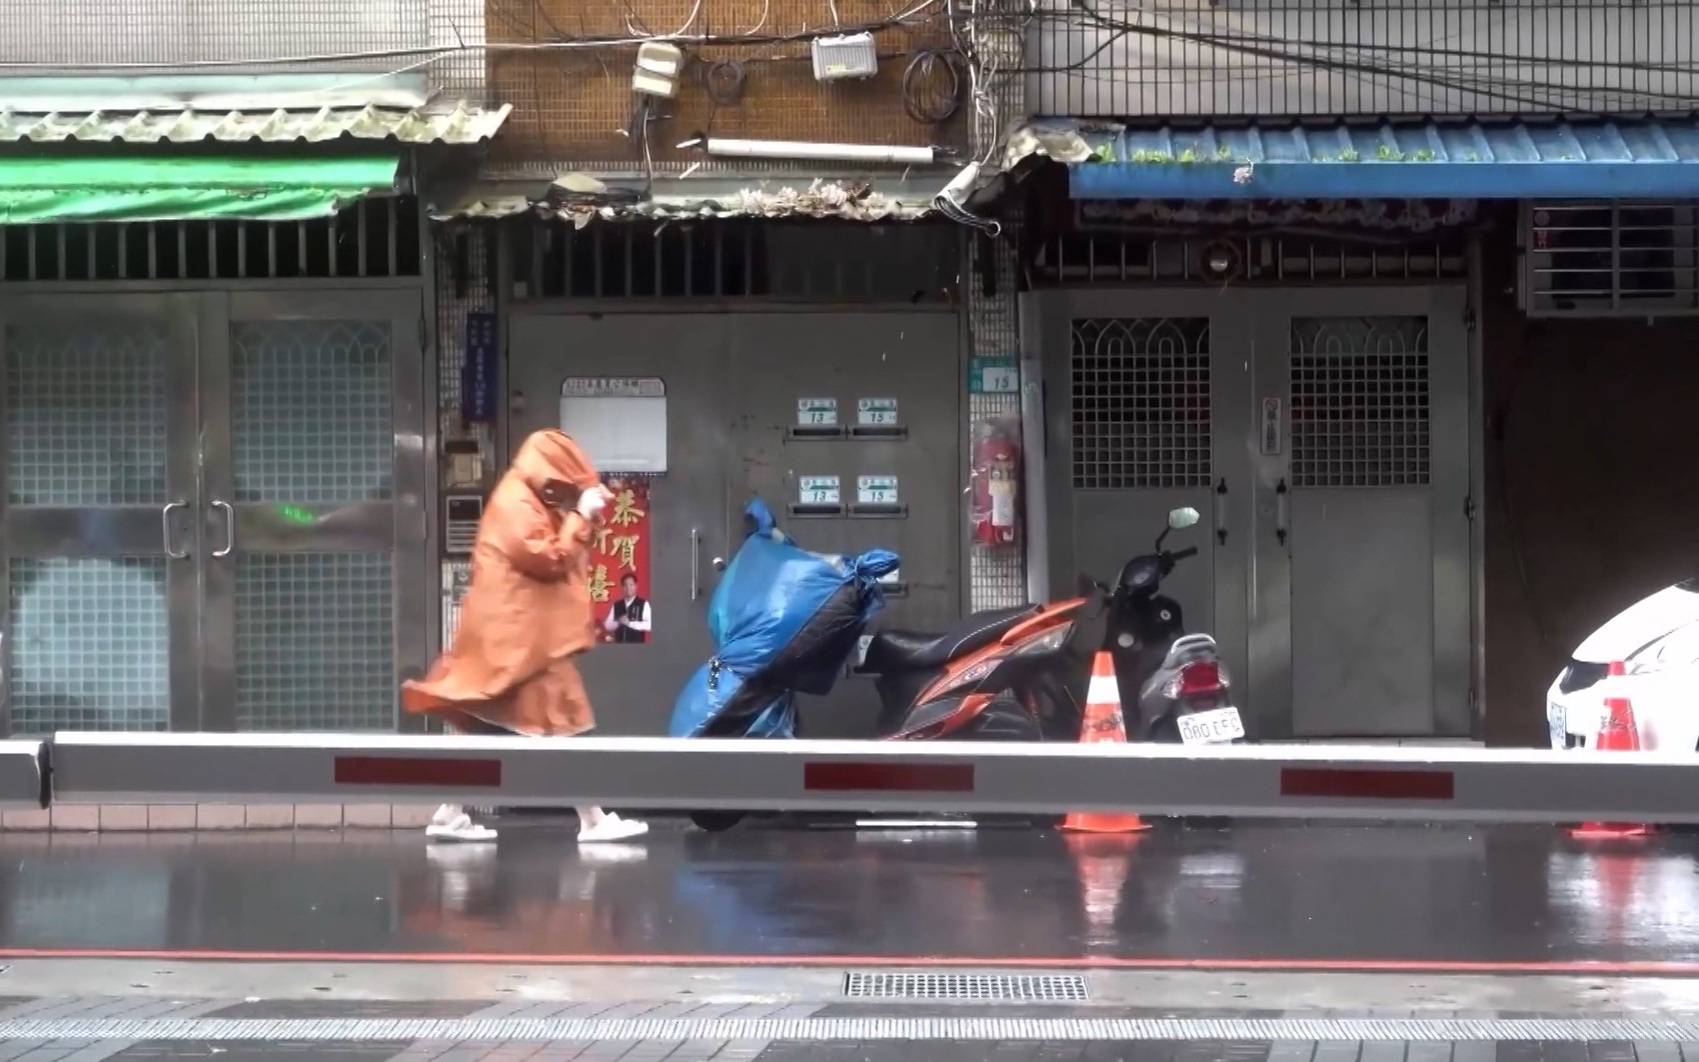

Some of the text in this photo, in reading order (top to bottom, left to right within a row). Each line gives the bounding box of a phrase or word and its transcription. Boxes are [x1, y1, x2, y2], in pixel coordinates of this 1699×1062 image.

[994, 375, 1010, 390] 15
[811, 413, 825, 424] 13
[871, 413, 884, 423] 15
[813, 491, 827, 501] 13
[872, 491, 884, 501] 15
[610, 489, 645, 572] 恭賀
